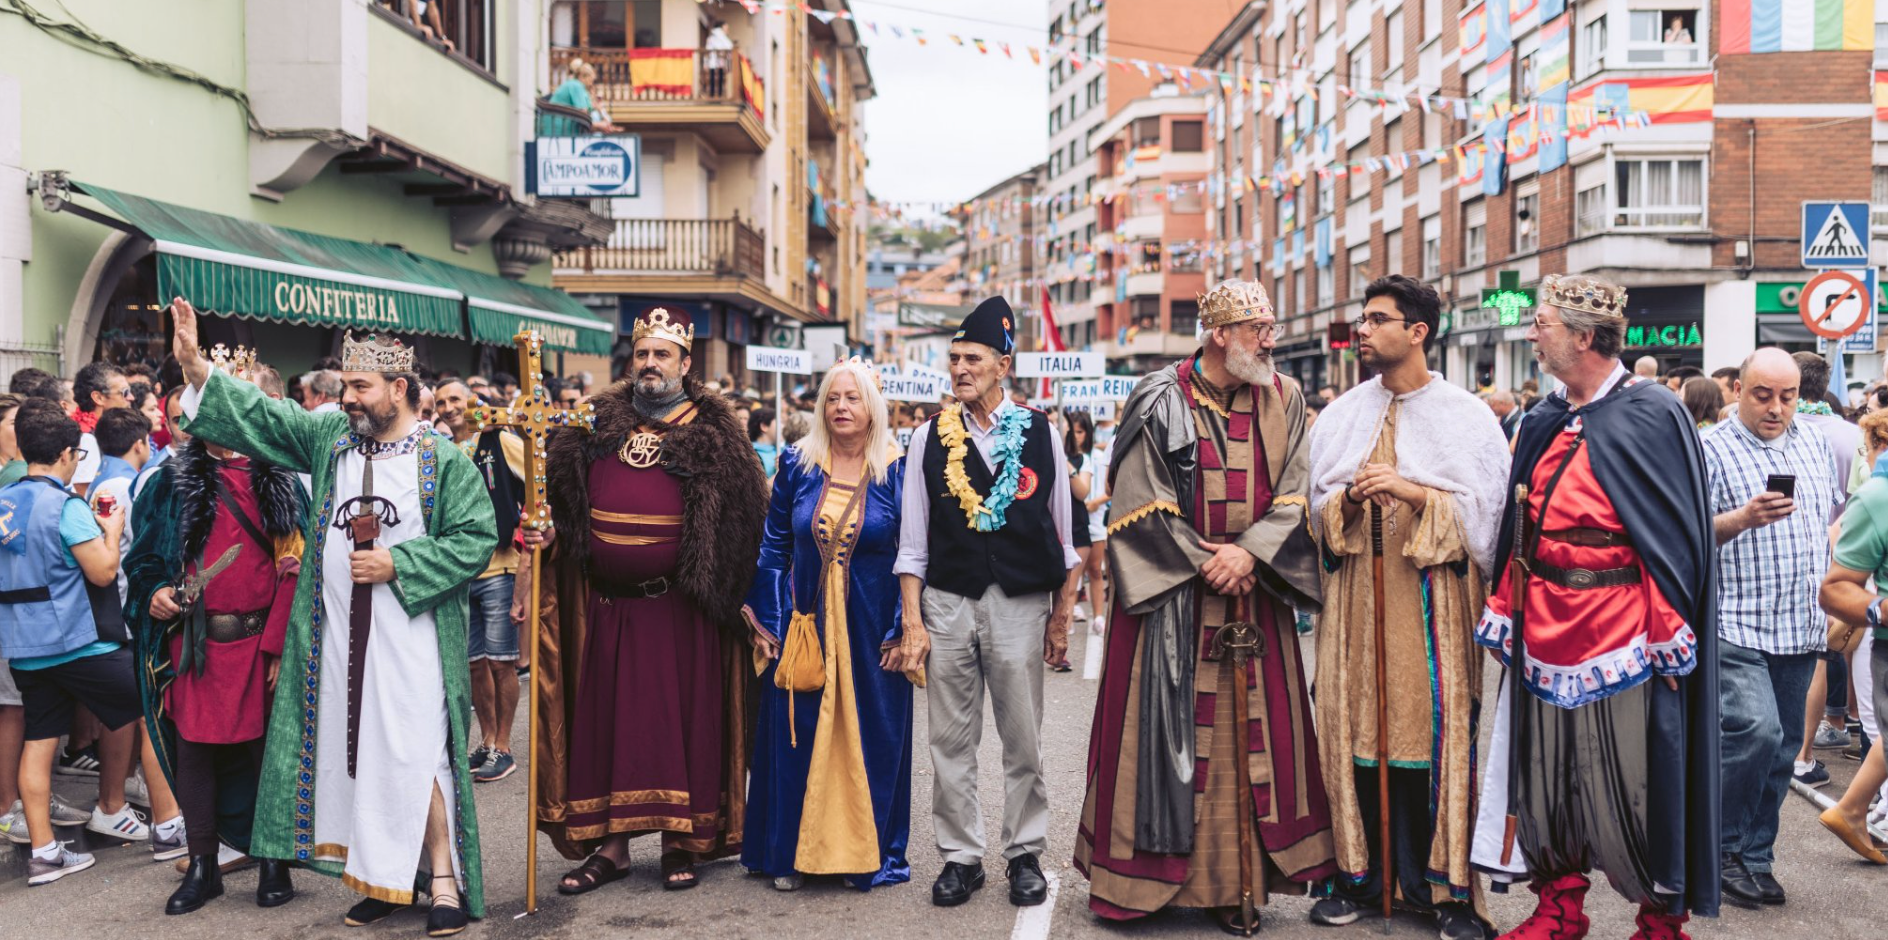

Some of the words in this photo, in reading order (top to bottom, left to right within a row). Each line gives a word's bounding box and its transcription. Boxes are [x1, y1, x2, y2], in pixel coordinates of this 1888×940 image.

[275, 281, 400, 323] CONFITERIA
[756, 353, 800, 370] HUNGRIA
[1039, 356, 1082, 372] ITALIA
